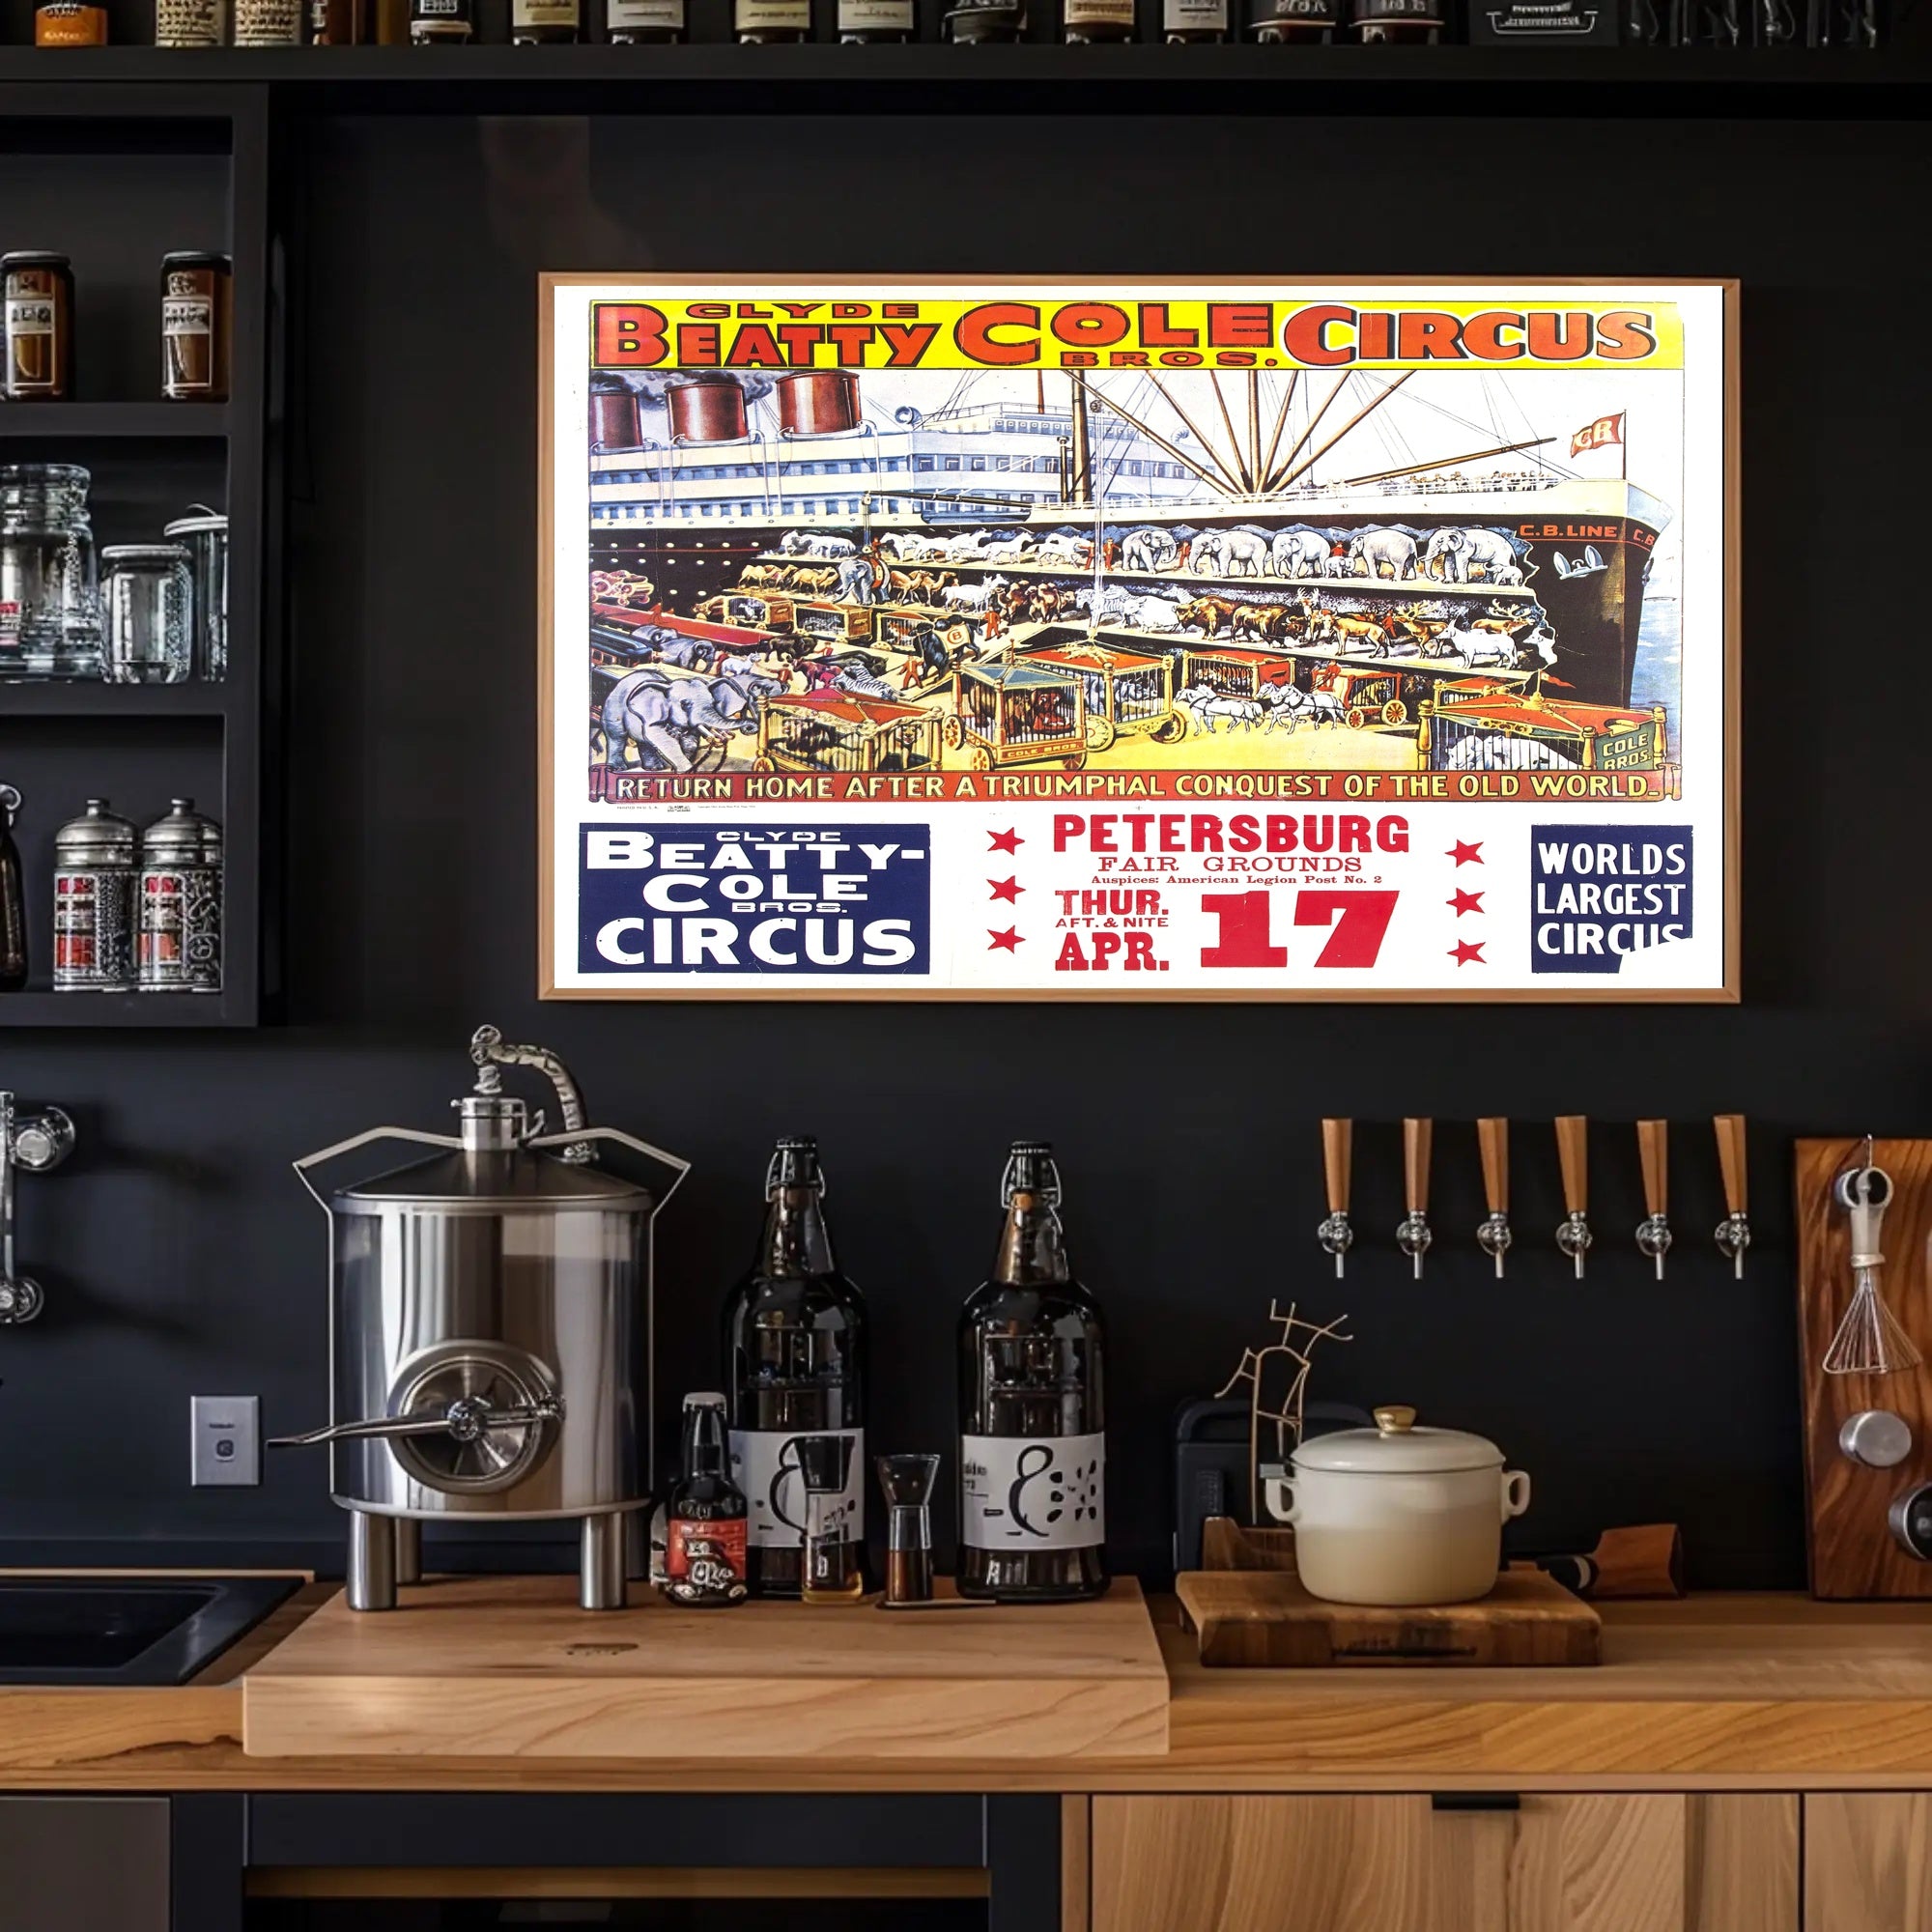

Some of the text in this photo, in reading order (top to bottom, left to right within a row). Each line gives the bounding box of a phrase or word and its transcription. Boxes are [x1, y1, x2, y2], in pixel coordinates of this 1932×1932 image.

[685, 302, 920, 320] CLYDE
[592, 301, 1658, 368] BEATTY COLE CIRCUS
[1059, 351, 1279, 368] BROS.
[1007, 749, 1038, 758] COLE
[1602, 732, 1649, 757] COLE
[615, 777, 732, 800] RETURN
[745, 776, 836, 799] HOME
[845, 776, 945, 799] AFTER
[956, 776, 977, 798] A
[982, 775, 1166, 798] TRIUMPHAL
[1175, 774, 1335, 798] CONQUEST
[1343, 774, 1382, 797] OF
[1388, 774, 1449, 797] THE
[1459, 774, 1520, 798] OLD
[716, 831, 841, 842] CLYDE
[1054, 814, 1409, 853] PETERSBURG
[586, 831, 924, 869] BEATTY-
[1538, 842, 1687, 875] WORLDS
[1097, 856, 1363, 872] FAIR GROUNDS
[642, 873, 868, 912] COLE
[1091, 875, 1382, 887] Auspices: American Legion Post No. 2
[731, 902, 848, 913] BROS.
[1055, 890, 1169, 916] THUR.
[1537, 883, 1687, 916] LARGEST
[1055, 917, 1169, 928] AFT. & NITE
[1201, 891, 1400, 968] 17
[595, 917, 916, 966] CIRCUS
[1055, 932, 1170, 971] APR.
